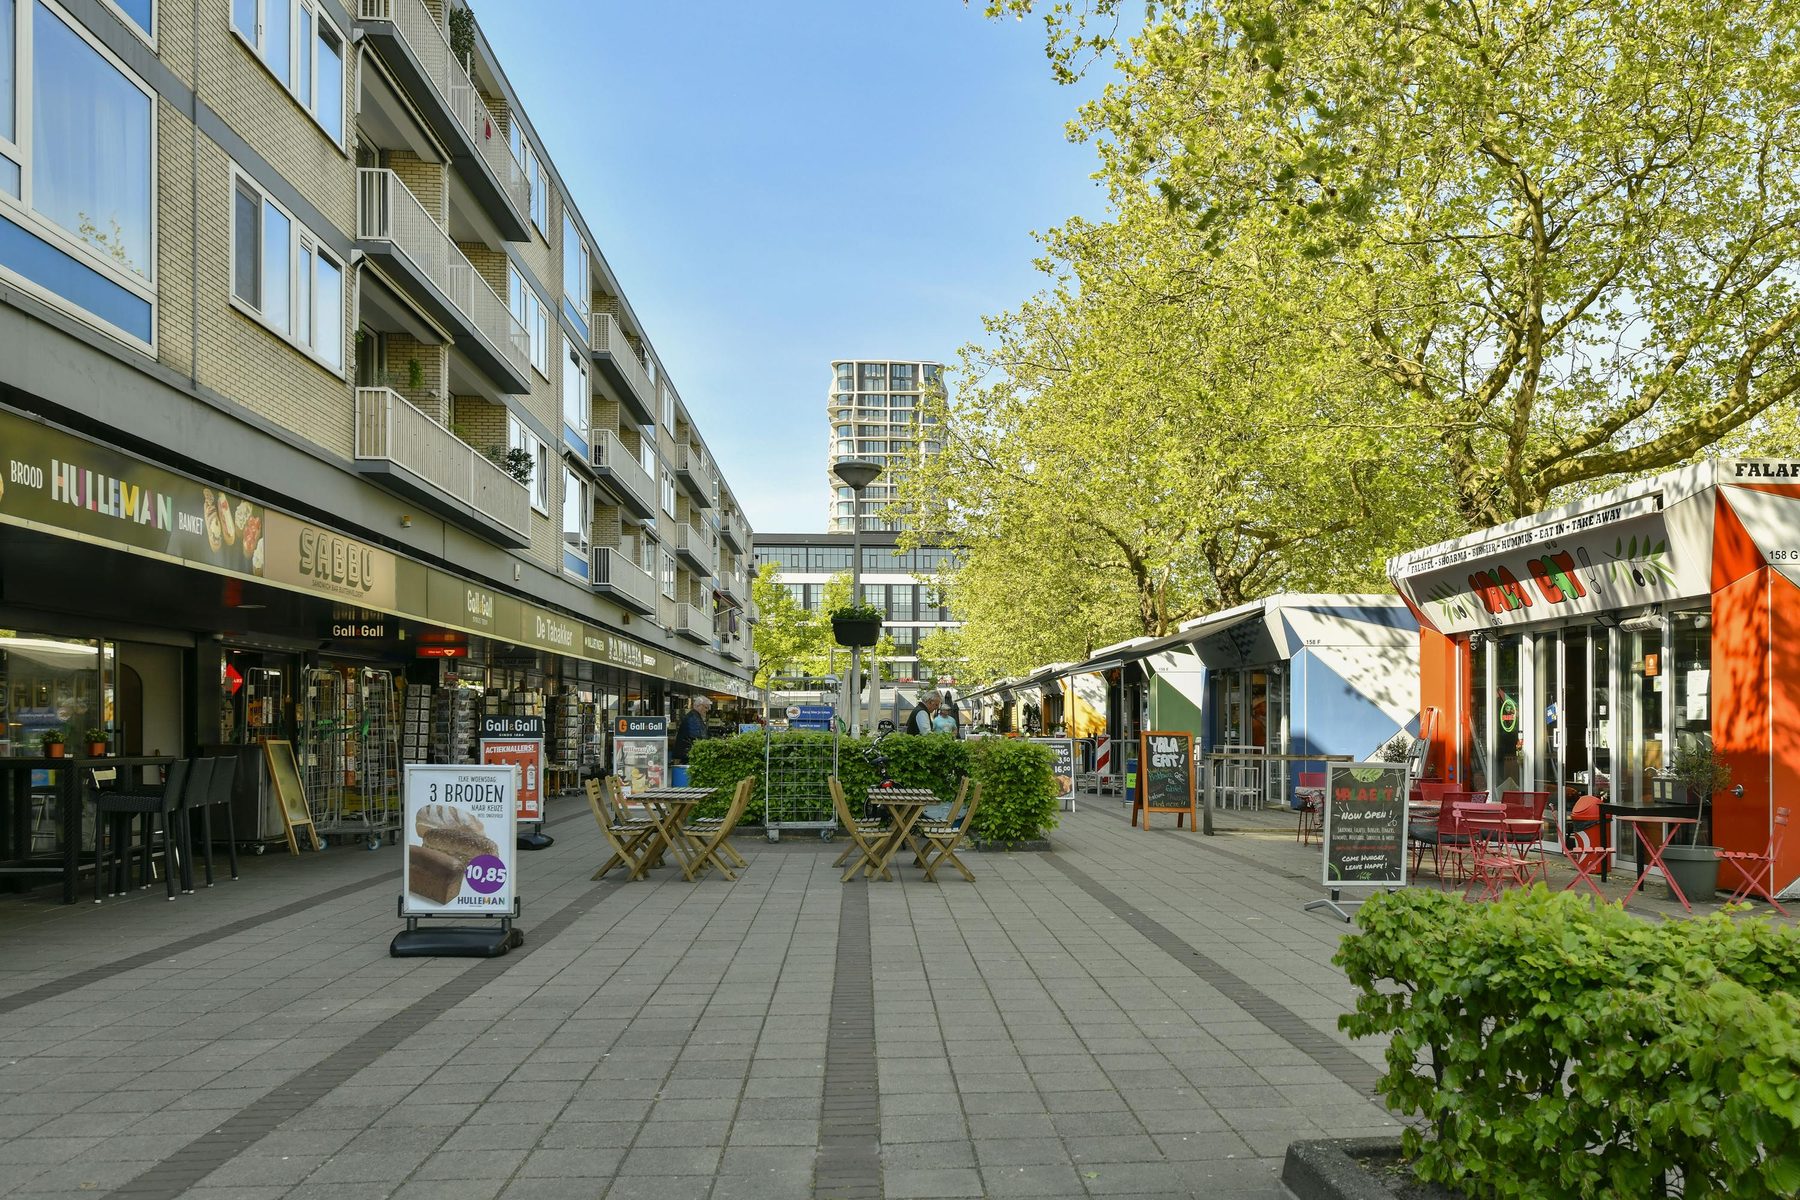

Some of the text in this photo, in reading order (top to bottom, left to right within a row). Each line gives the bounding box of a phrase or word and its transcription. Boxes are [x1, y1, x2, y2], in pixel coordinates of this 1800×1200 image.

[10, 460, 43, 489] BROOD
[52, 458, 172, 532] HULLEMAN
[178, 511, 204, 536] BANKET
[1411, 560, 1434, 574] FALAFEL
[1438, 550, 1468, 566] SHOARMA
[1502, 532, 1534, 550] HUMMUS
[1539, 526, 1554, 539] EAT
[1556, 523, 1564, 535] IN
[1571, 514, 1594, 530] TAKE
[1596, 508, 1622, 523] AWAY
[299, 527, 374, 592] SABBU
[1769, 550, 1798, 560] 158 G
[536, 615, 546, 640] De
[546, 619, 572, 646] Tabakker
[485, 744, 534, 753] ACTIEKNALLERS!
[429, 784, 504, 803] 3 BRODEN
[466, 864, 507, 883] 10,85
[457, 896, 505, 905] HULLEMAN
